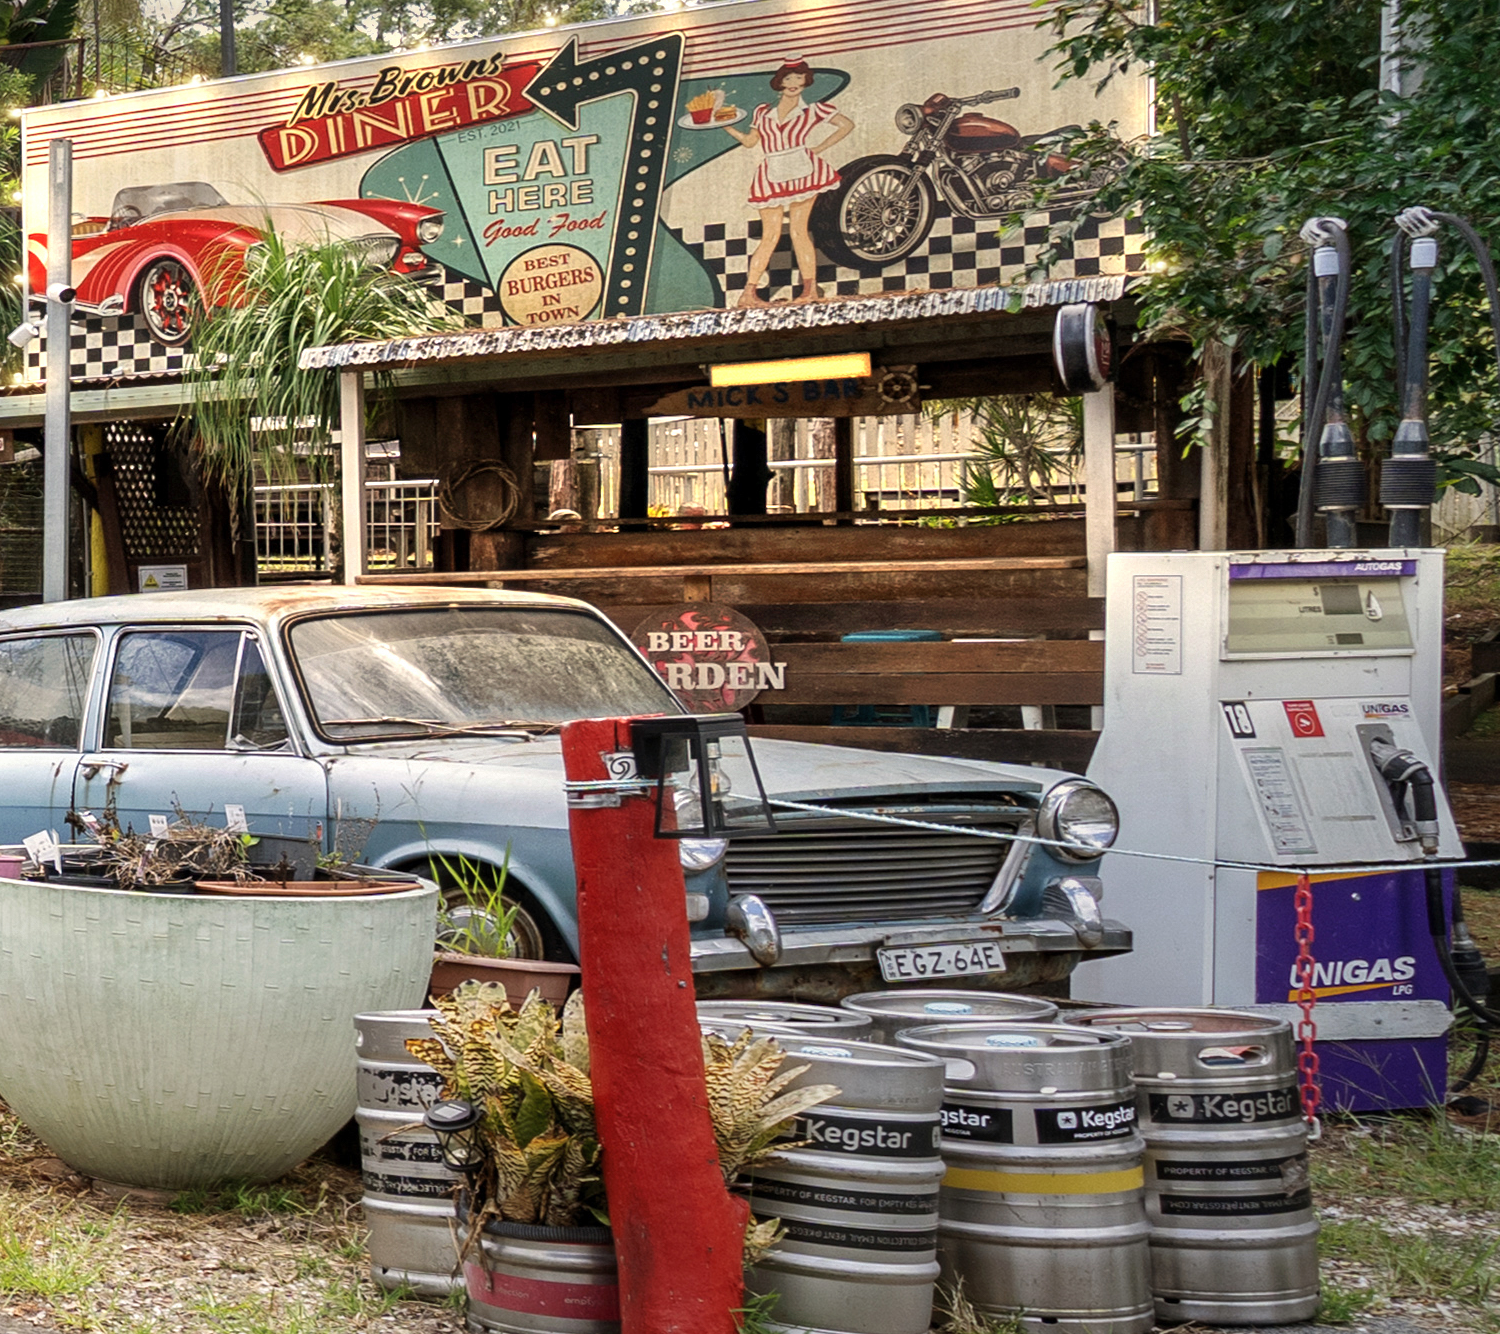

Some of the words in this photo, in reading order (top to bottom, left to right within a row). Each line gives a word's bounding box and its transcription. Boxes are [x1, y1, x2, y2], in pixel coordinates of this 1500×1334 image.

[286, 80, 366, 127] Mrs.
[370, 52, 506, 107] Browns
[278, 78, 512, 166] DINER
[458, 132, 487, 144] EST.
[490, 120, 521, 137] 2021
[483, 134, 599, 186] EAT
[489, 179, 594, 214] HERE
[482, 217, 541, 248] Good
[547, 210, 608, 239] Food
[524, 253, 571, 272] BEST
[506, 266, 595, 297] BURGERS
[541, 293, 561, 307] IN
[526, 305, 580, 325] TOWN
[801, 377, 859, 401] BAR
[1354, 562, 1402, 572] AUTOGAS
[647, 630, 746, 653] BEER
[655, 661, 788, 691] RDEN
[1362, 703, 1409, 714] UNIGAS
[1289, 955, 1417, 988] UNIGAS
[1392, 984, 1413, 996] LPG
[941, 1109, 991, 1128] gstar
[1080, 1105, 1136, 1129] Kegstar
[1202, 1092, 1293, 1123] Kegstar
[806, 1118, 912, 1151] Kegstar
[1163, 1166, 1214, 1176] PROPERTY
[1215, 1167, 1228, 1176] OF
[799, 1190, 812, 1201] OF
[860, 1197, 877, 1208] FOR
[878, 1198, 905, 1210] EMPTY
[850, 1233, 876, 1244] EMAIL
